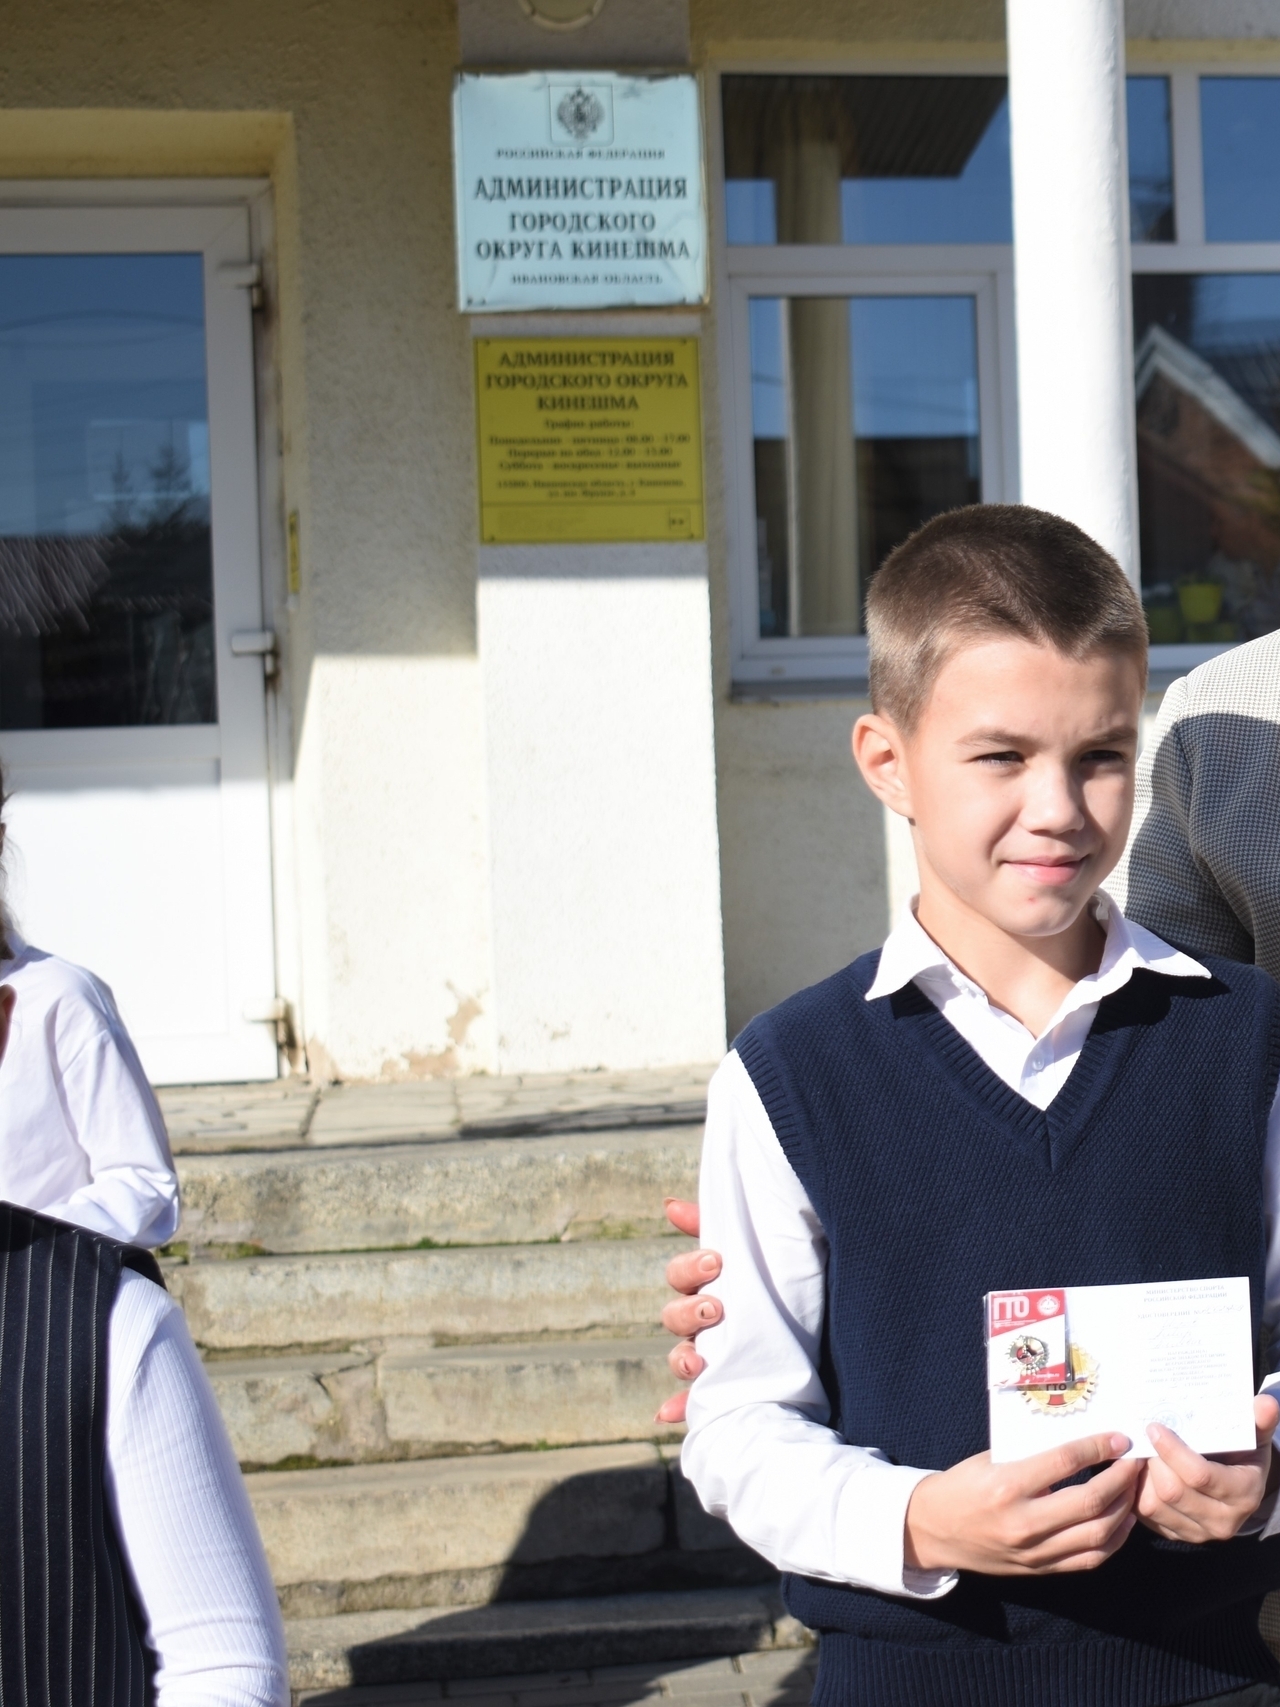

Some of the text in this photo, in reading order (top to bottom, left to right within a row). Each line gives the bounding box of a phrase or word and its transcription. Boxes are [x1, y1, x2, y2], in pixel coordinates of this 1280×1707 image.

[495, 148, 666, 160] РОССИЙСКАЯ ФЕДЕРАЦИЯ
[475, 177, 688, 202] АДМИНИСТРАЦИЯ
[509, 212, 657, 234] ГОРОДСКОГО
[476, 240, 690, 261] ОКРУГА КИНЕШМА
[499, 351, 675, 369] АДМИНИСТРАЦИЯ
[486, 373, 689, 390] ГОРОДСКОГО ОКРУГА
[536, 395, 640, 411] КИНЕШМА
[993, 1295, 1030, 1320] ГТО
